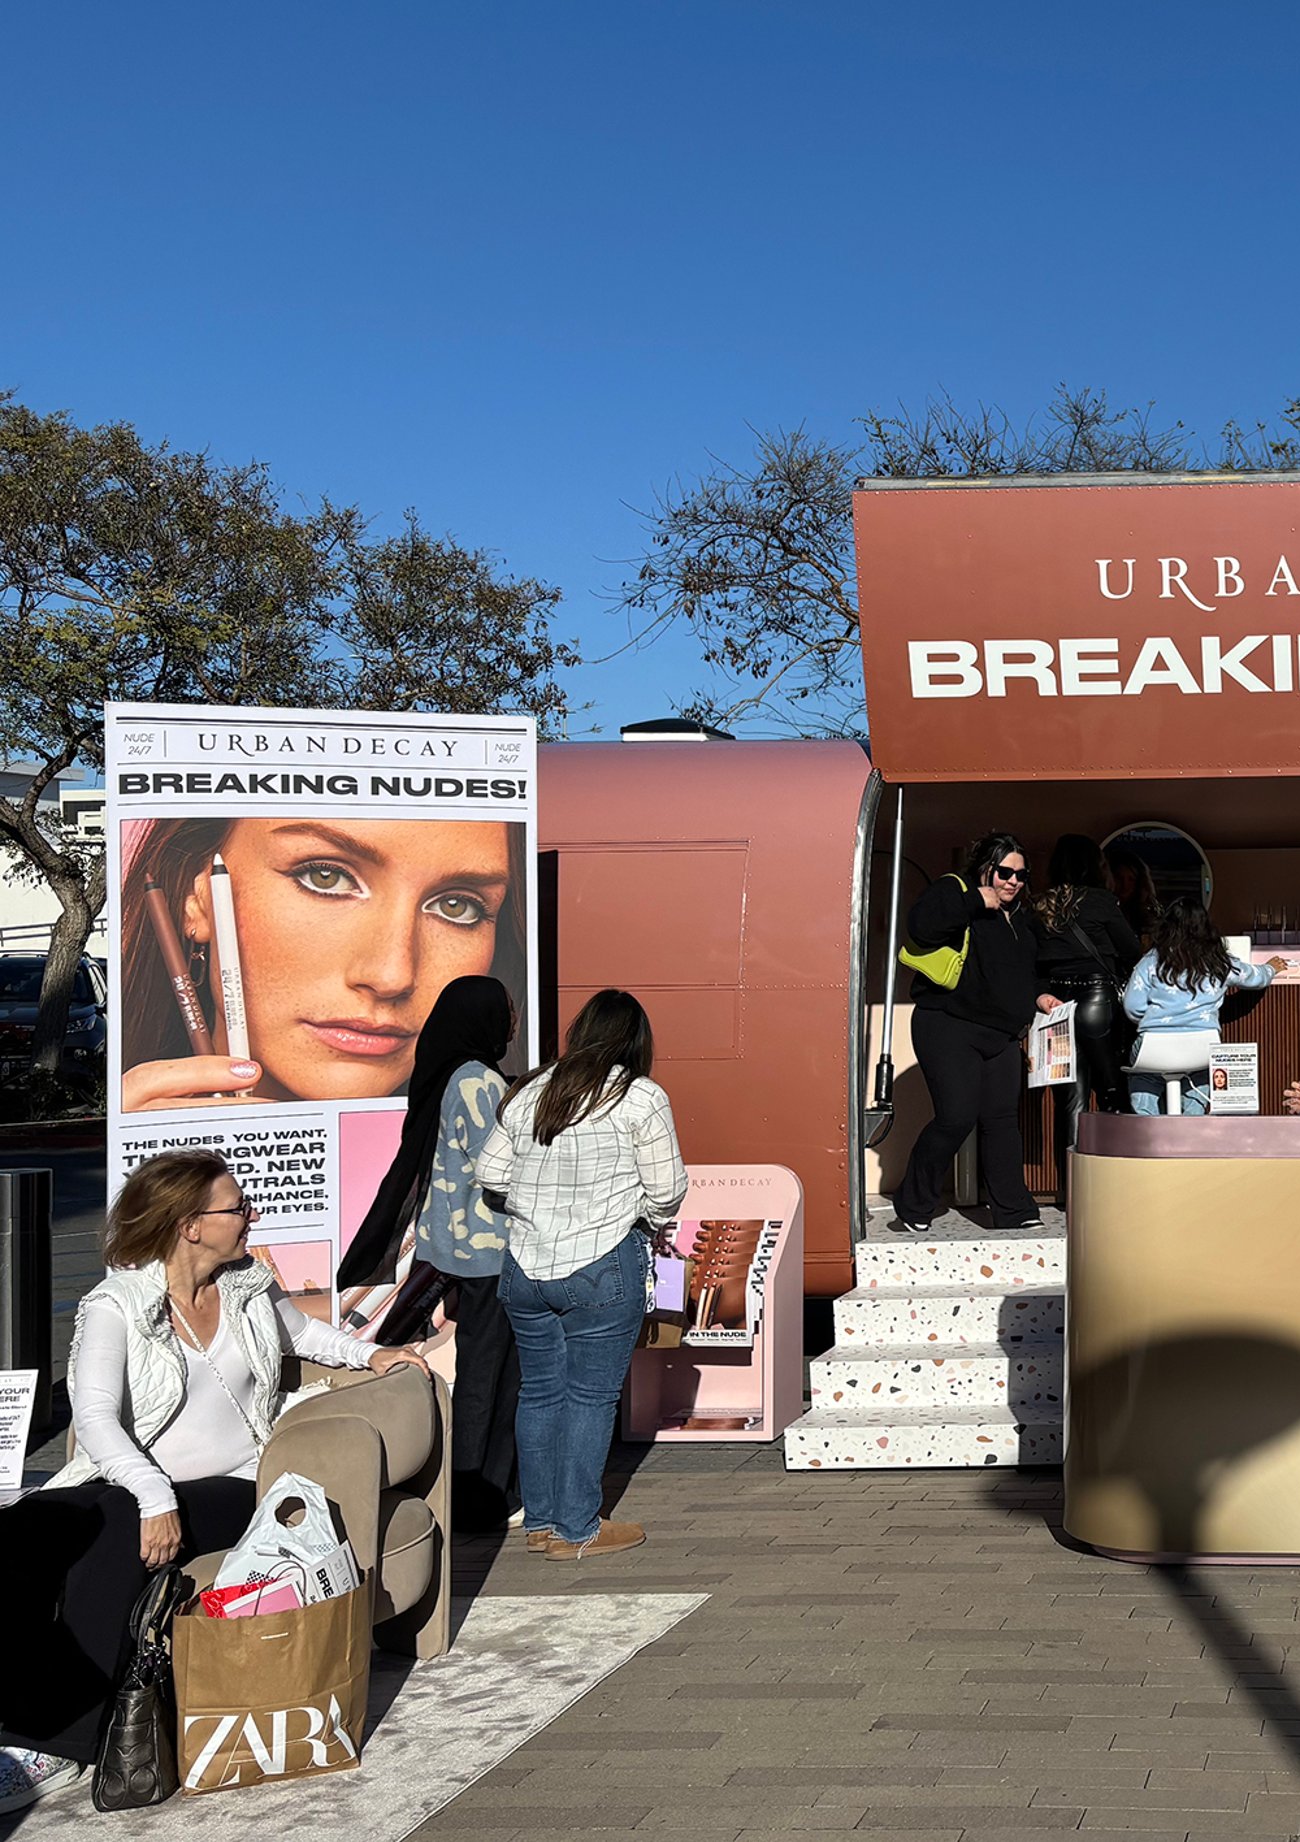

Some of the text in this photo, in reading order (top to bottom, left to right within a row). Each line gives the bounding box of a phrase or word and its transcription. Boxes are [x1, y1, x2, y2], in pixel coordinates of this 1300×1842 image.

[123, 733, 155, 743] NUDE
[198, 733, 458, 757] URBAN DECAY
[128, 746, 152, 756] 24/7
[494, 743, 522, 752] NUDE
[498, 754, 519, 764] 24/7
[118, 773, 527, 800] BREAKING NUDES!
[122, 1128, 328, 1151] THE NUDES YOU WANT.
[214, 1141, 326, 1159] NGWEAR
[267, 1157, 326, 1173] NEW
[692, 1177, 772, 1189] RBAN DECAY
[244, 1189, 329, 1203] NHANCE.
[281, 1202, 329, 1214] EYES.
[184, 1693, 358, 1791] ZARA
